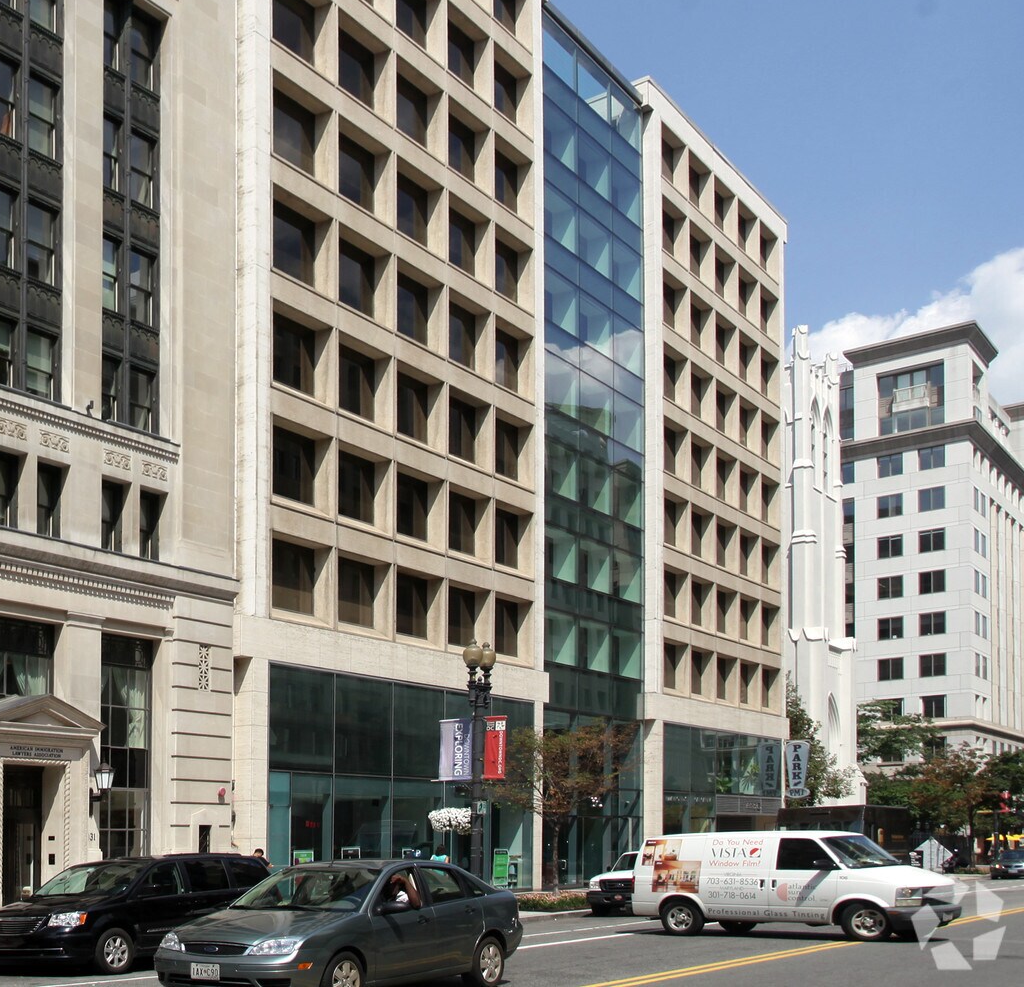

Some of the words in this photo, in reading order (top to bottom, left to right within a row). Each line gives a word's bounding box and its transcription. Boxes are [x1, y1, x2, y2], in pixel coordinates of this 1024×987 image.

[454, 723, 464, 776] EXPLORING
[463, 733, 471, 776] DOWNTOWN
[792, 745, 802, 780] PARK
[712, 847, 747, 858] VISTA
[706, 877, 758, 886] 703-631-8536
[708, 891, 756, 900] 301-718-0614
[708, 908, 760, 917] Professional
[764, 909, 788, 918] Glass
[792, 911, 826, 920] Tinting
